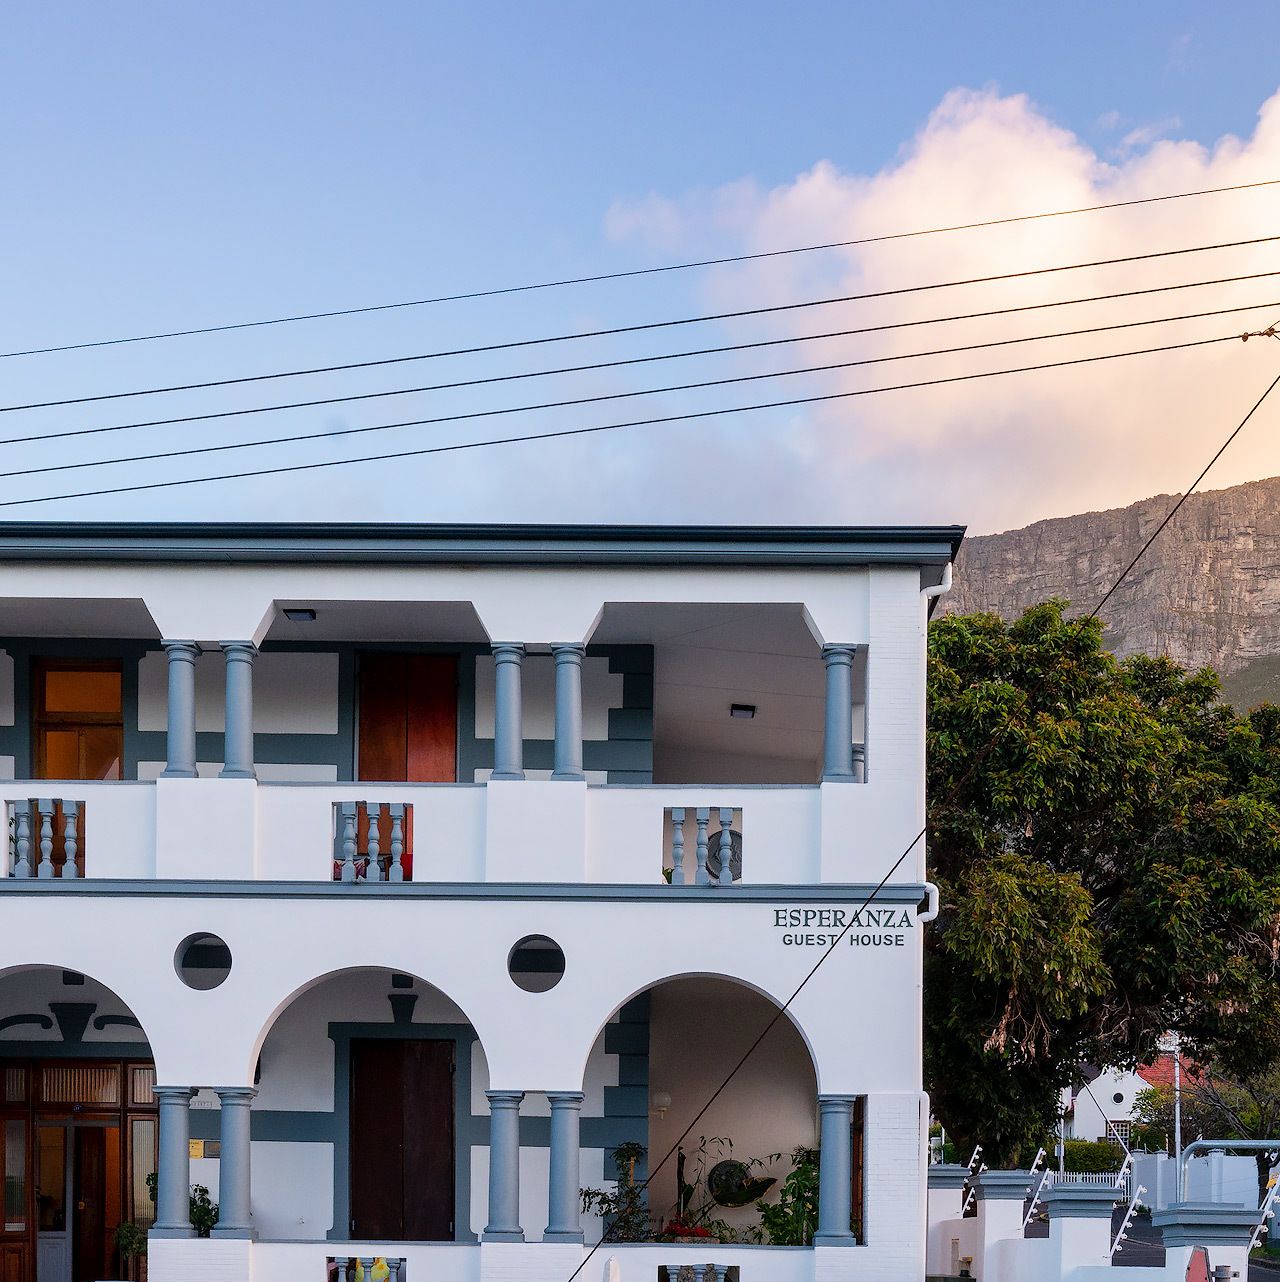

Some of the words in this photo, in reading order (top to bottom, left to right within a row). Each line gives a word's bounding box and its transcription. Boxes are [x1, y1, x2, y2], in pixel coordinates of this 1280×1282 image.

[773, 908, 914, 928] ESPERANZA
[782, 934, 838, 946] GUEST
[850, 934, 905, 946] HOUSE
